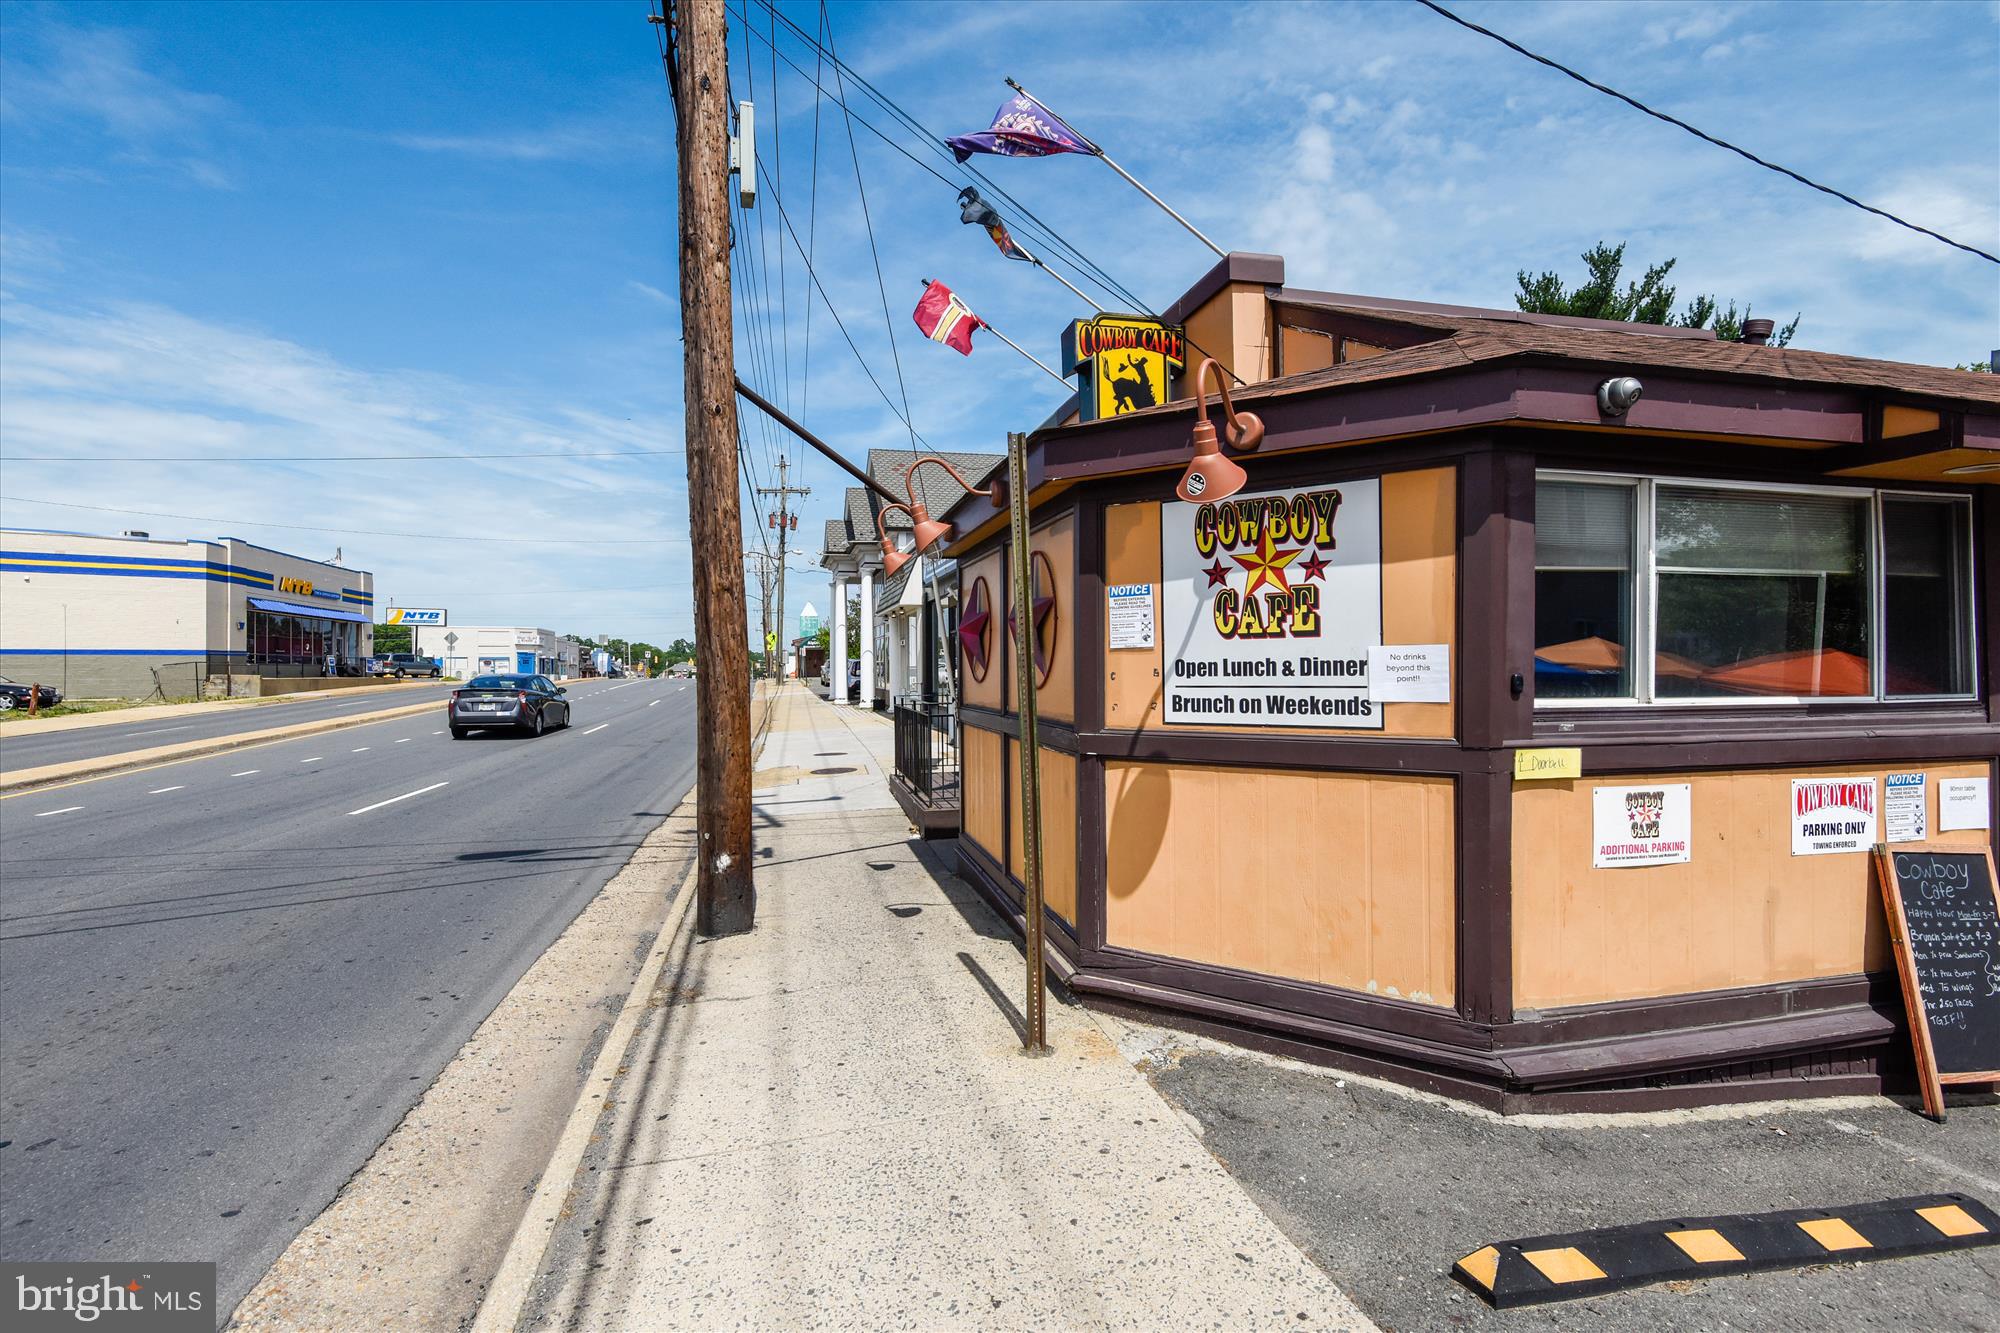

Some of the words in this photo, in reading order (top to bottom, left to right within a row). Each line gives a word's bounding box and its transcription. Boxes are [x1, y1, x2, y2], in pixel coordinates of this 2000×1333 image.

[1080, 324, 1139, 356] COWBOY
[1141, 328, 1182, 361] CAFE
[1195, 489, 1342, 559] COWBOY
[279, 577, 313, 595] NTB
[1110, 585, 1149, 597] NOTICE
[1214, 584, 1321, 640] CAFE
[1403, 653, 1427, 661] drinks
[1175, 658, 1218, 679] Open
[1223, 658, 1276, 677] Lunch
[1282, 660, 1295, 677] &
[1300, 657, 1368, 677] Dinner
[1396, 675, 1420, 683] point!!
[1172, 695, 1234, 714] Brunch
[1239, 698, 1262, 714] on
[1266, 695, 1372, 716] Weekends
[1532, 755, 1566, 771] Doorbell
[1888, 774, 1923, 785] NOTICE
[1625, 791, 1664, 811] COWBOY
[1795, 783, 1842, 820] COWBOY
[1846, 782, 1874, 818] CAFE
[1631, 820, 1659, 838] CAFE
[1803, 823, 1842, 836] PARKING
[1845, 821, 1866, 835] ONLY
[1600, 844, 1649, 855] ADDITIONAL
[1652, 841, 1685, 852] PARKING
[1833, 841, 1856, 849] ENFORCED
[1896, 855, 1968, 889] Cowboy
[1921, 880, 1955, 899] Cafe
[1908, 909, 1932, 918] Happy
[1936, 909, 1955, 918] Hour
[1957, 909, 1980, 920] Mon-Fri
[1982, 911, 1995, 920] 3-7
[1911, 929, 1940, 942] Brunch
[1975, 931, 1992, 940] 9-3
[1955, 999, 1973, 1007] Tacos
[1930, 1011, 1964, 1026] TGIF!!
